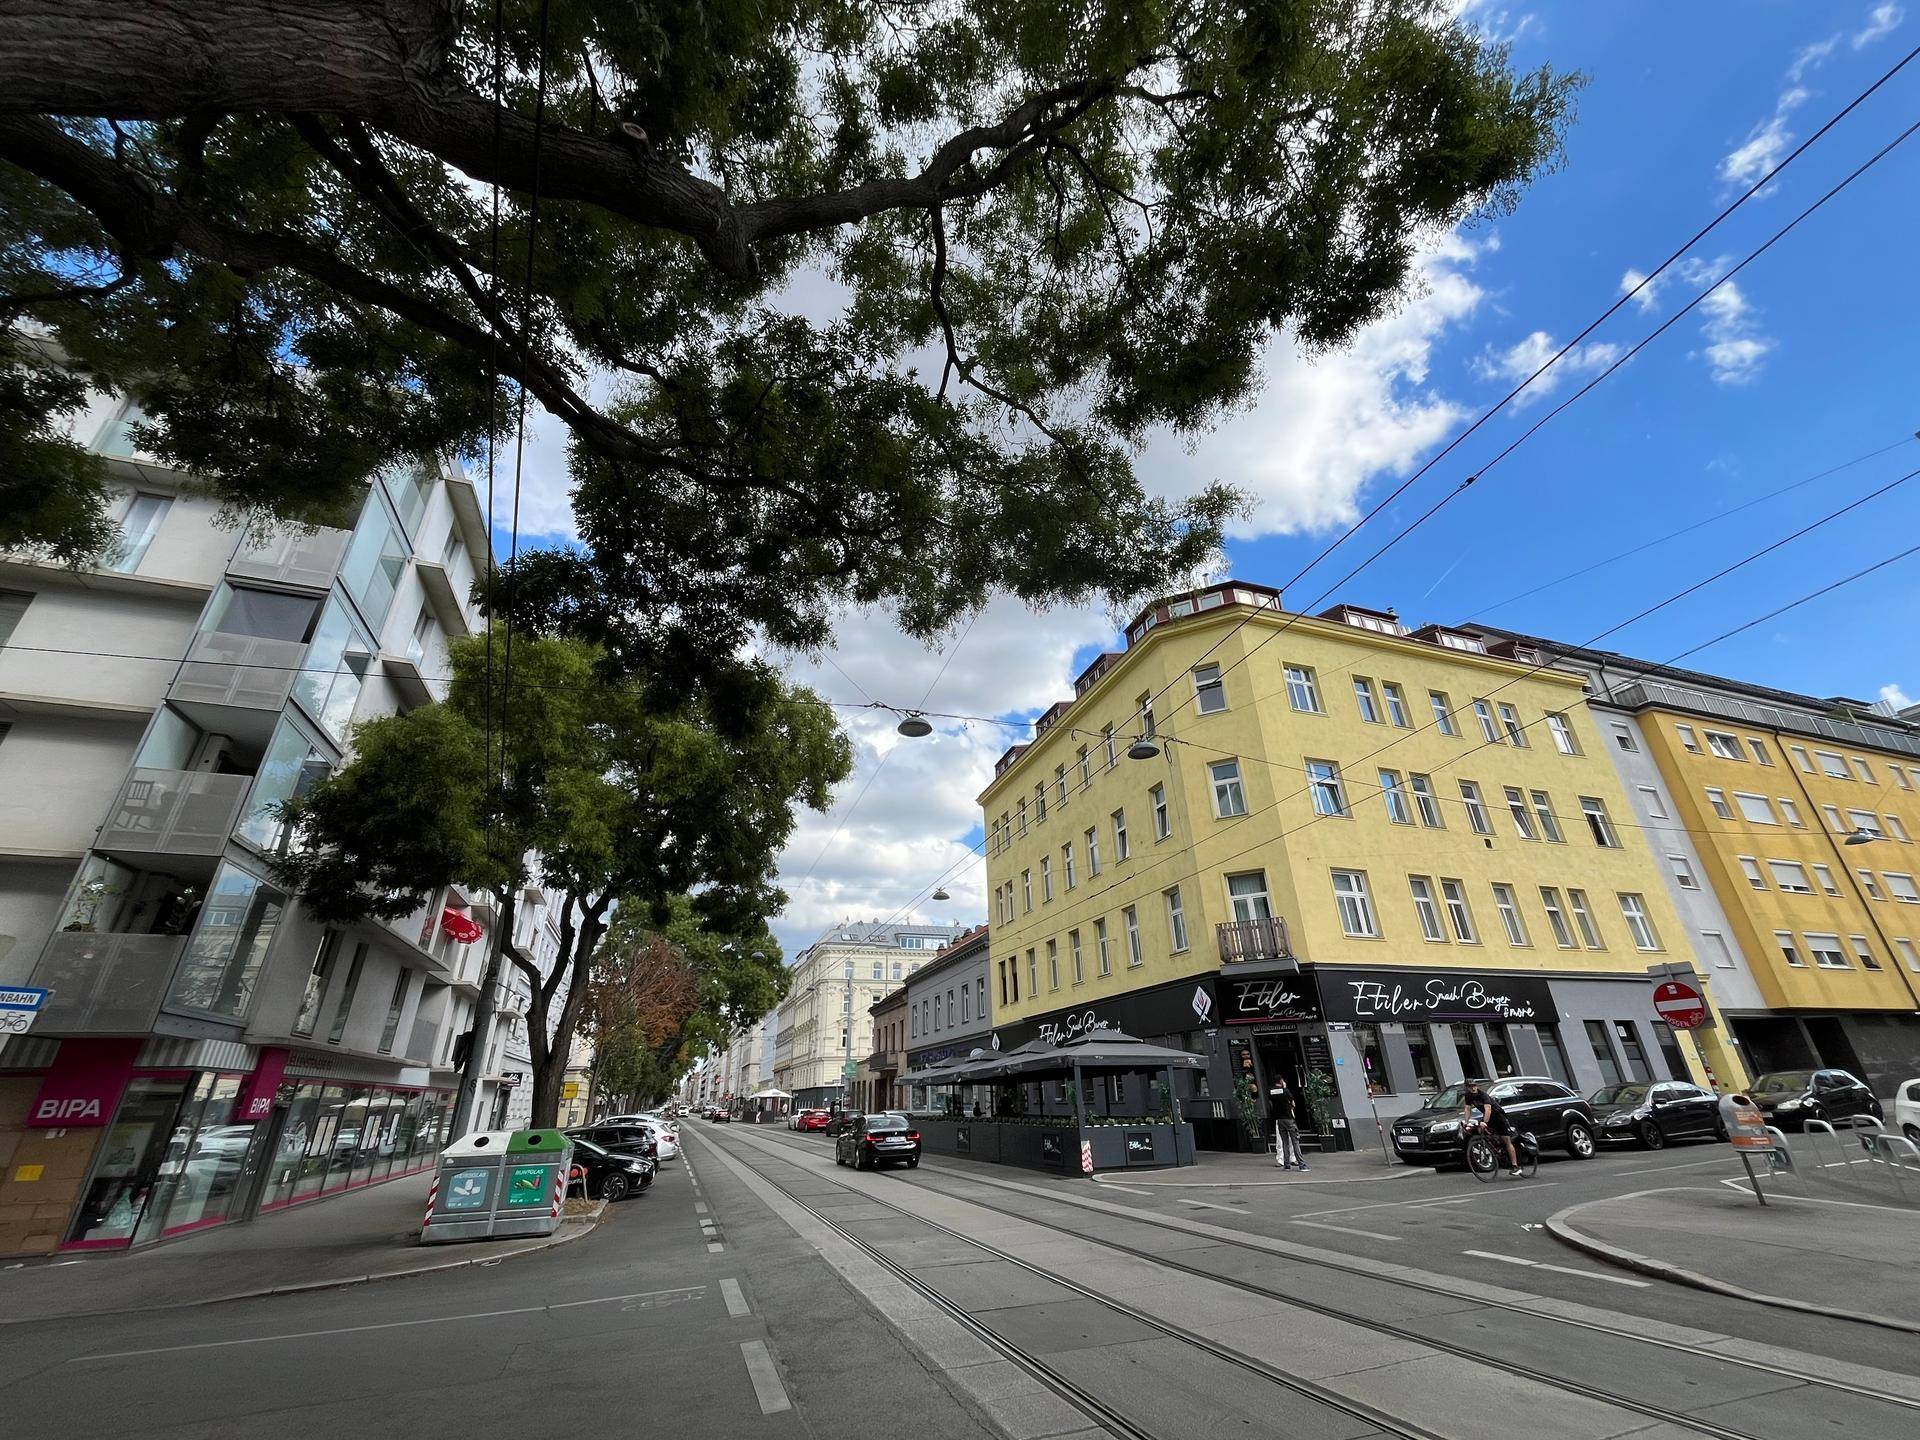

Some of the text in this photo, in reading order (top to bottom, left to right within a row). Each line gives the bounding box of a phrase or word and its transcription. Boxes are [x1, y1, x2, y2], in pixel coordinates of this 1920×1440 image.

[1233, 981, 1301, 1011] Etiler
[1348, 981, 1422, 1015] Etiler
[1460, 981, 1511, 1012] Burger
[1039, 1023, 1066, 1046] Etiler
[36, 1098, 101, 1119] BIPA
[249, 1097, 271, 1114] BIPA
